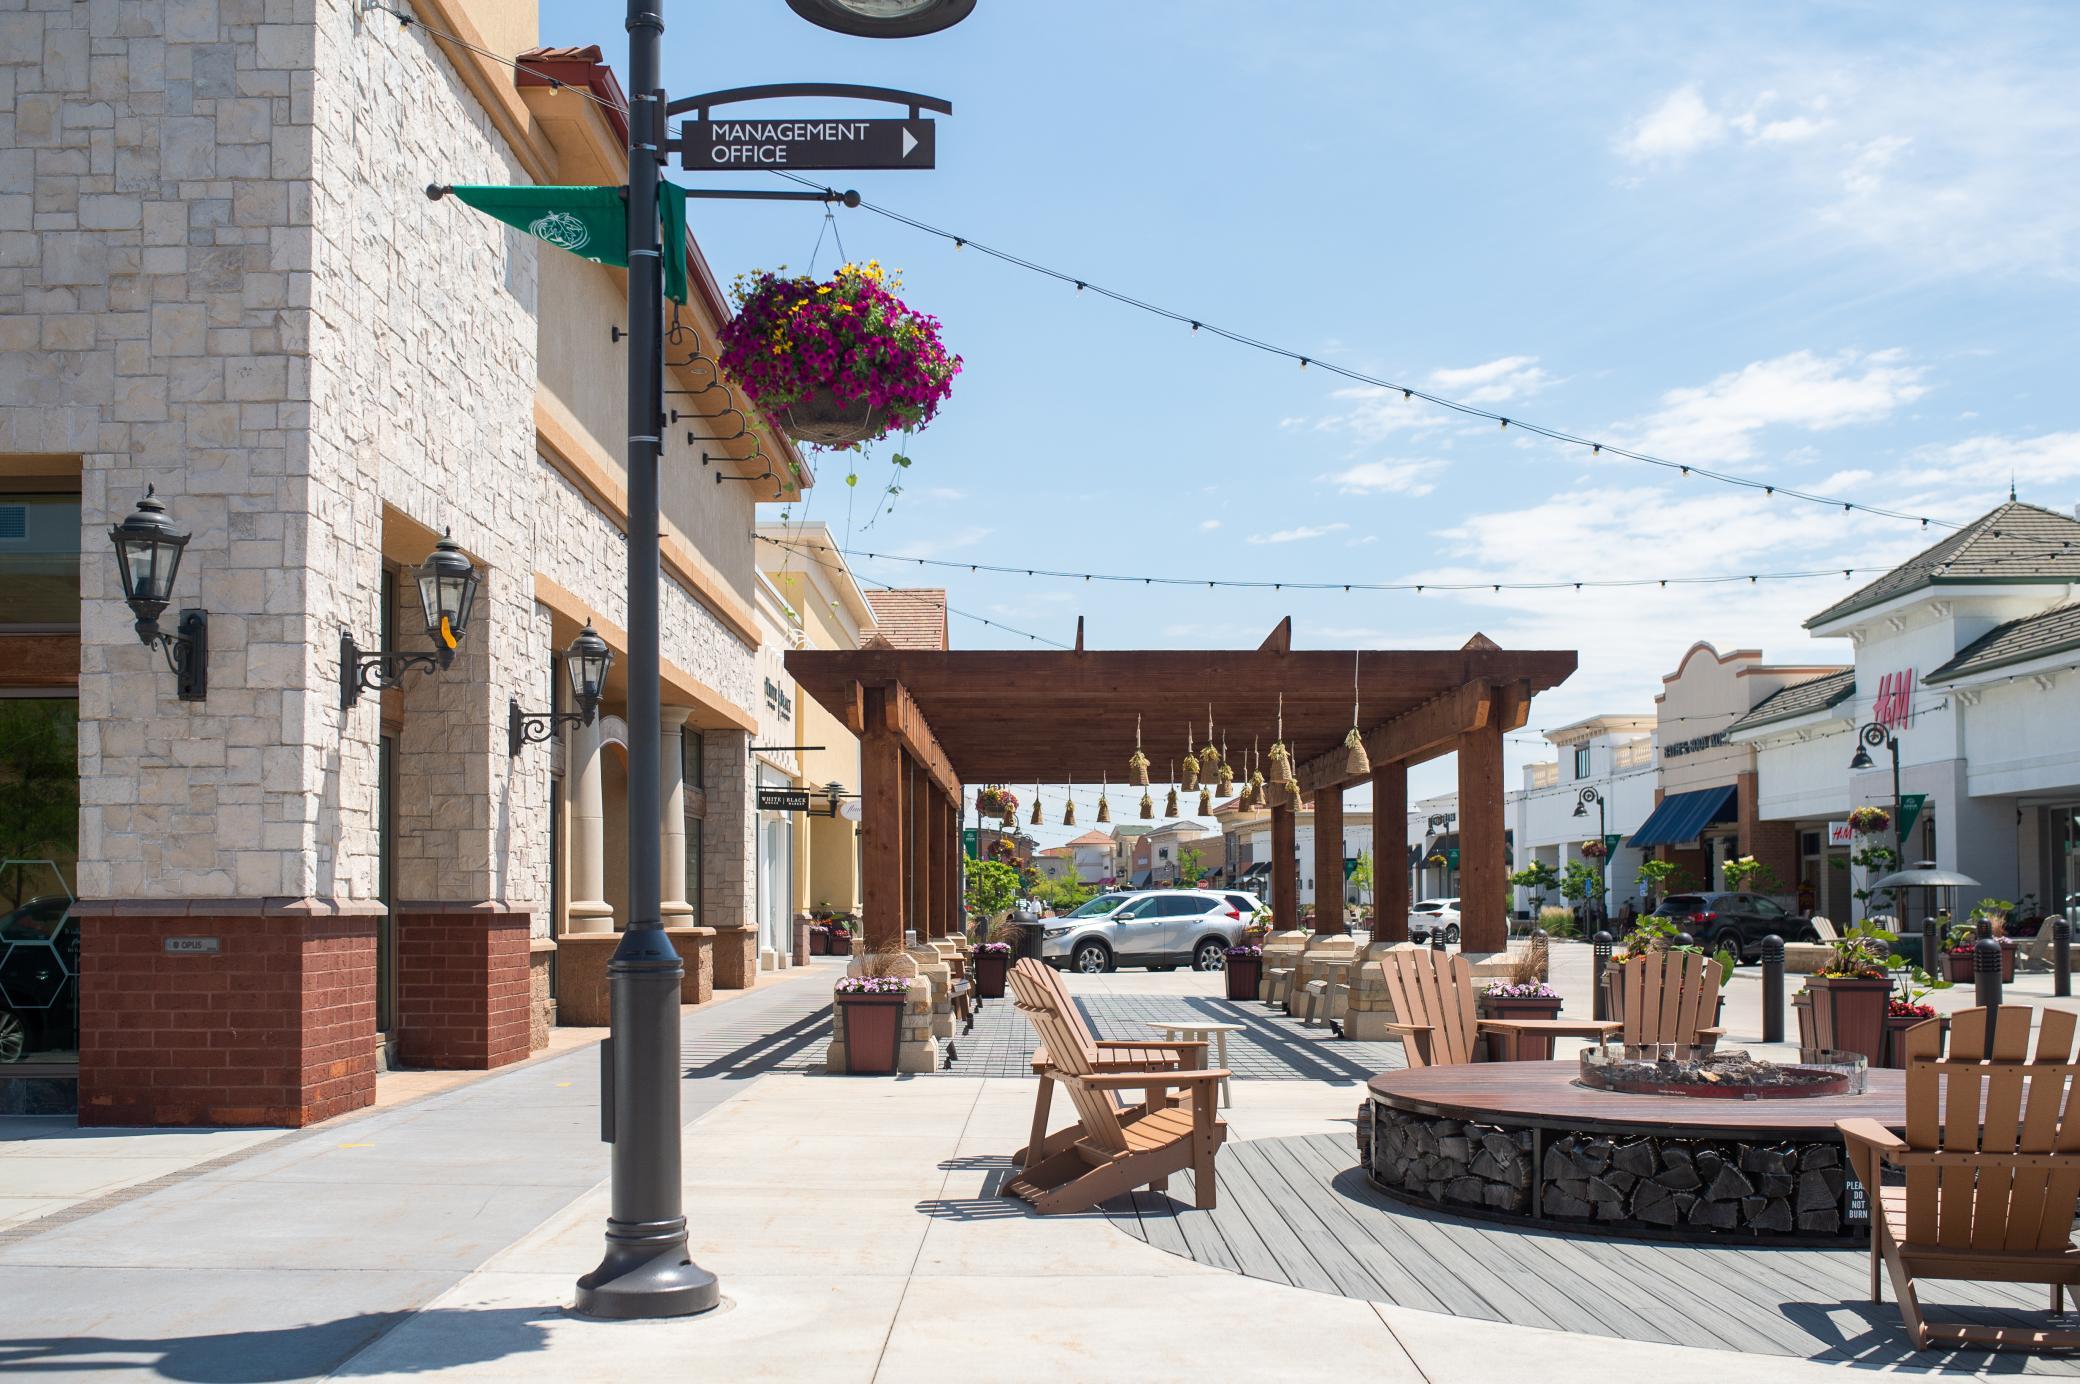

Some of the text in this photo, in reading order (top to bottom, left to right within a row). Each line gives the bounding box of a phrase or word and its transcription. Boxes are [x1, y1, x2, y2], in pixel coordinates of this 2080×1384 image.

[711, 123, 870, 141] MANAGEMENT
[711, 145, 787, 163] OFFICE
[1873, 668, 1912, 730] H&M
[1846, 1181, 1865, 1190] PLEA
[1853, 1191, 1863, 1199] DO
[1851, 1200, 1866, 1209] NOT
[1848, 1210, 1868, 1219] BURN
